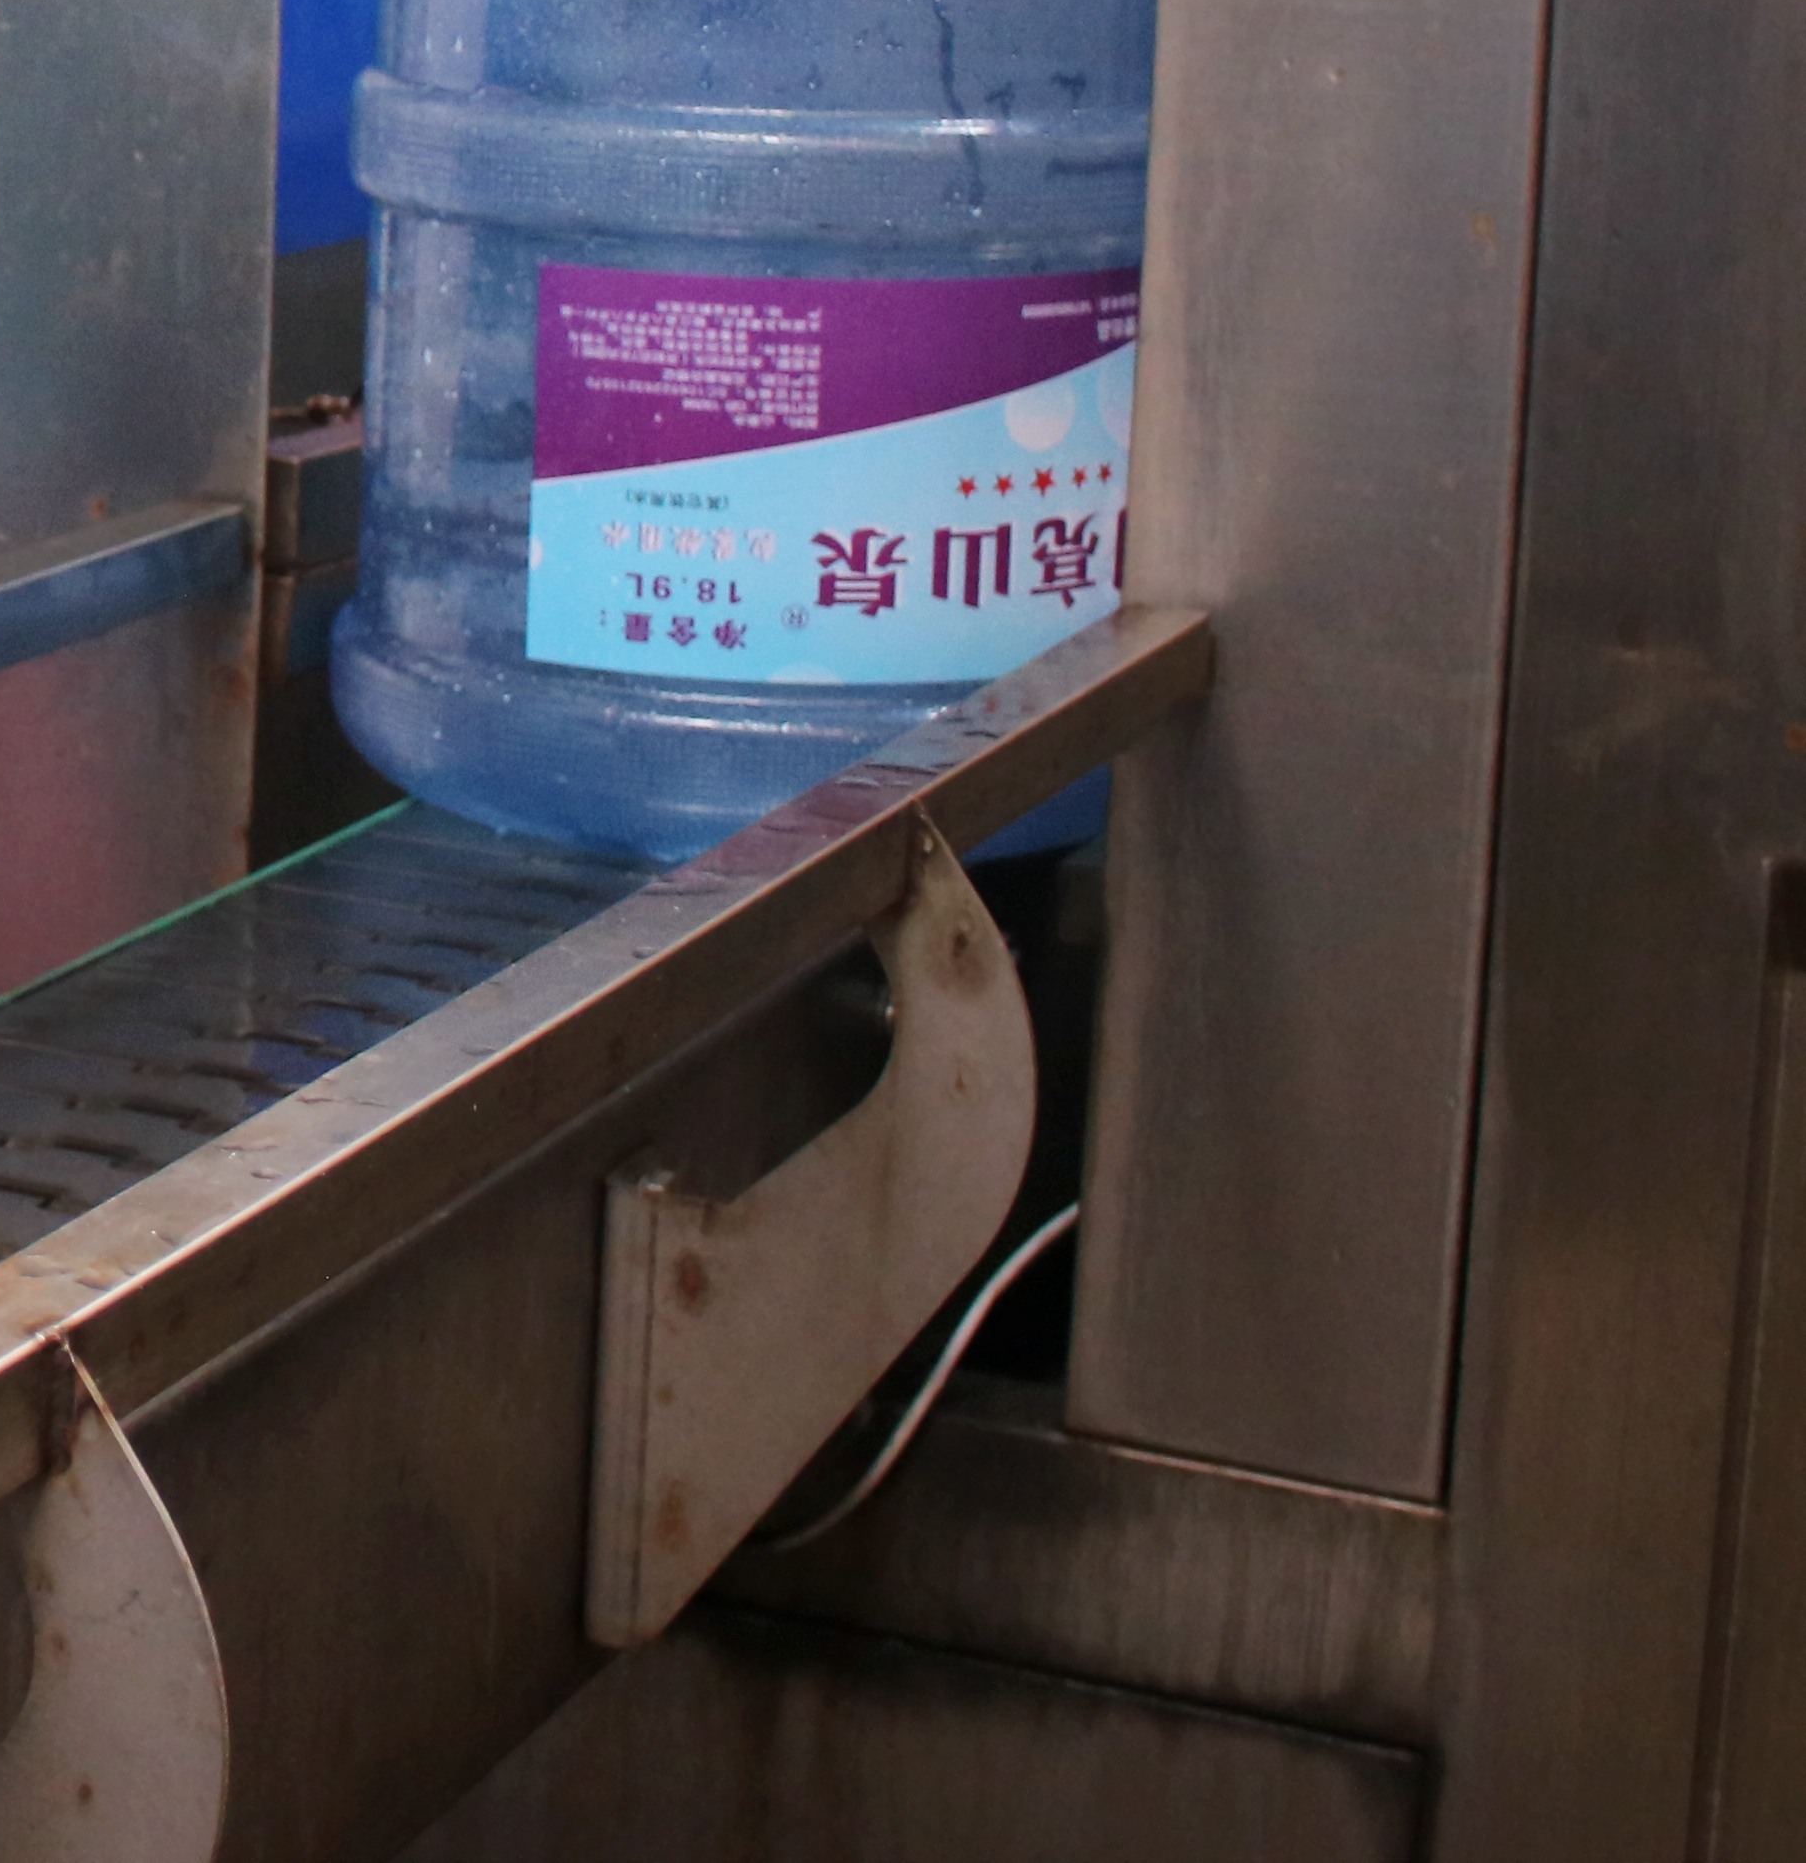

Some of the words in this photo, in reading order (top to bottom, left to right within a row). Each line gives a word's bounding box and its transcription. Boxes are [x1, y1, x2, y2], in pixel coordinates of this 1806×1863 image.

[625, 572, 742, 605] 18.9L
[810, 510, 1126, 618] 亮山泉
